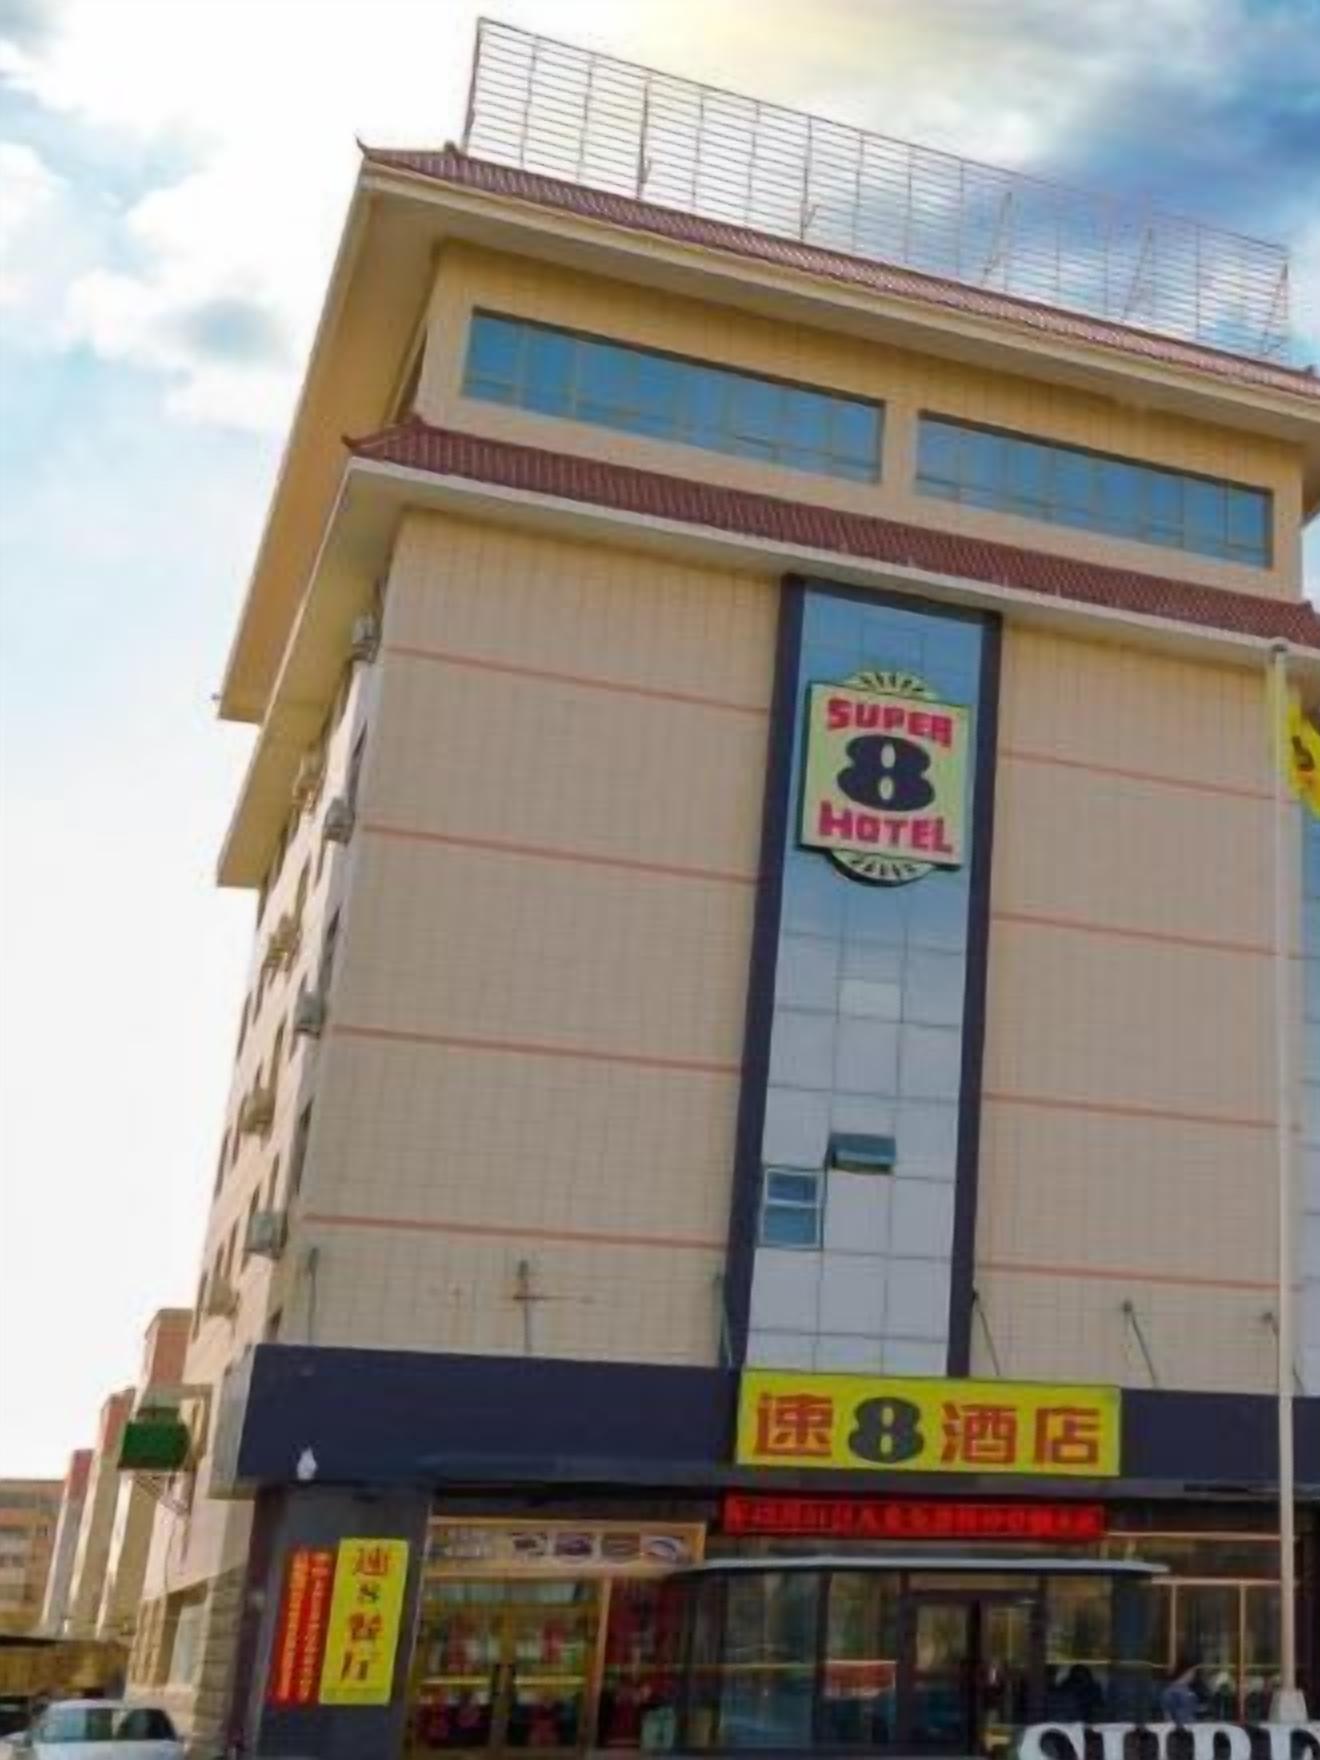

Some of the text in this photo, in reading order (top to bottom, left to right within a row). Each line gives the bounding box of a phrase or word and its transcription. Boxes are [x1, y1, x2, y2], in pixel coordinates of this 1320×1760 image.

[826, 697, 953, 749] SUPER
[837, 734, 936, 812] 8
[818, 799, 954, 854] HOTEL
[752, 1391, 1101, 1465] 速8酒店
